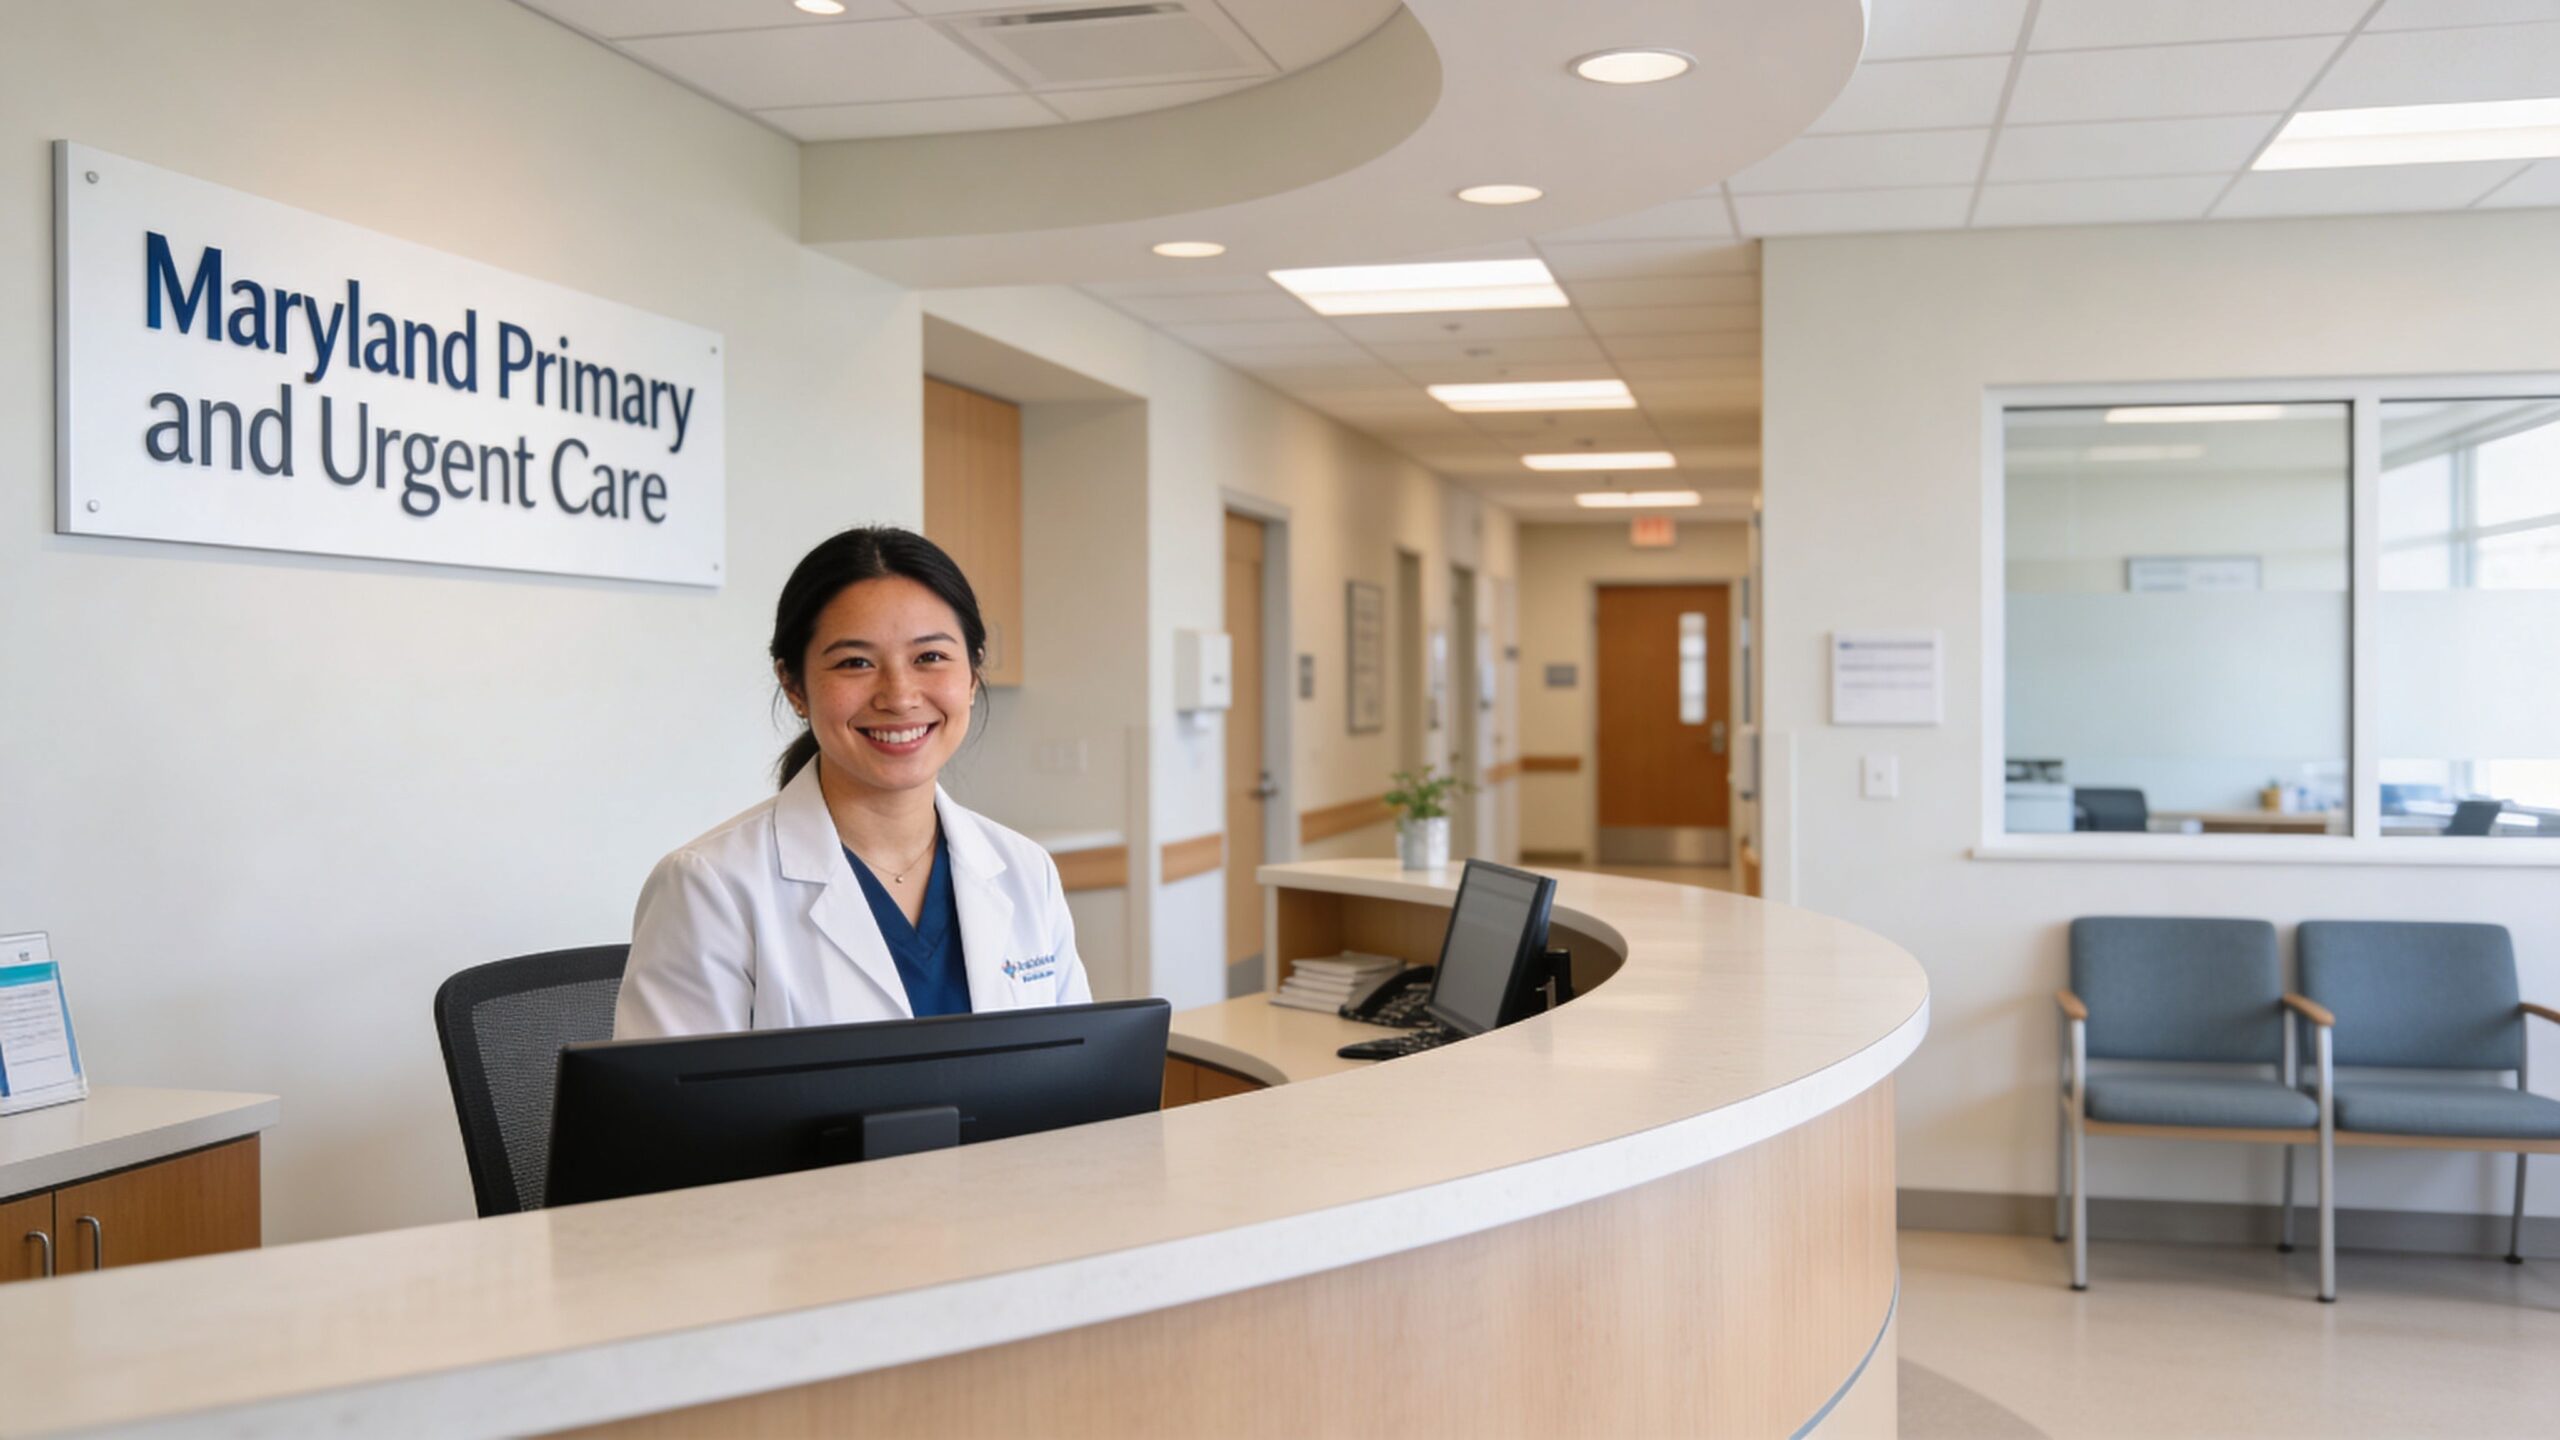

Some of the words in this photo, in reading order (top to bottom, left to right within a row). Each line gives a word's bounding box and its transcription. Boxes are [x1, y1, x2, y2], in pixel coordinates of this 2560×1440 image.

[145, 231, 478, 393] Maryland
[498, 320, 695, 453] Primary
[145, 383, 294, 478] and
[320, 395, 537, 518] Urgent
[551, 437, 668, 525] Care
